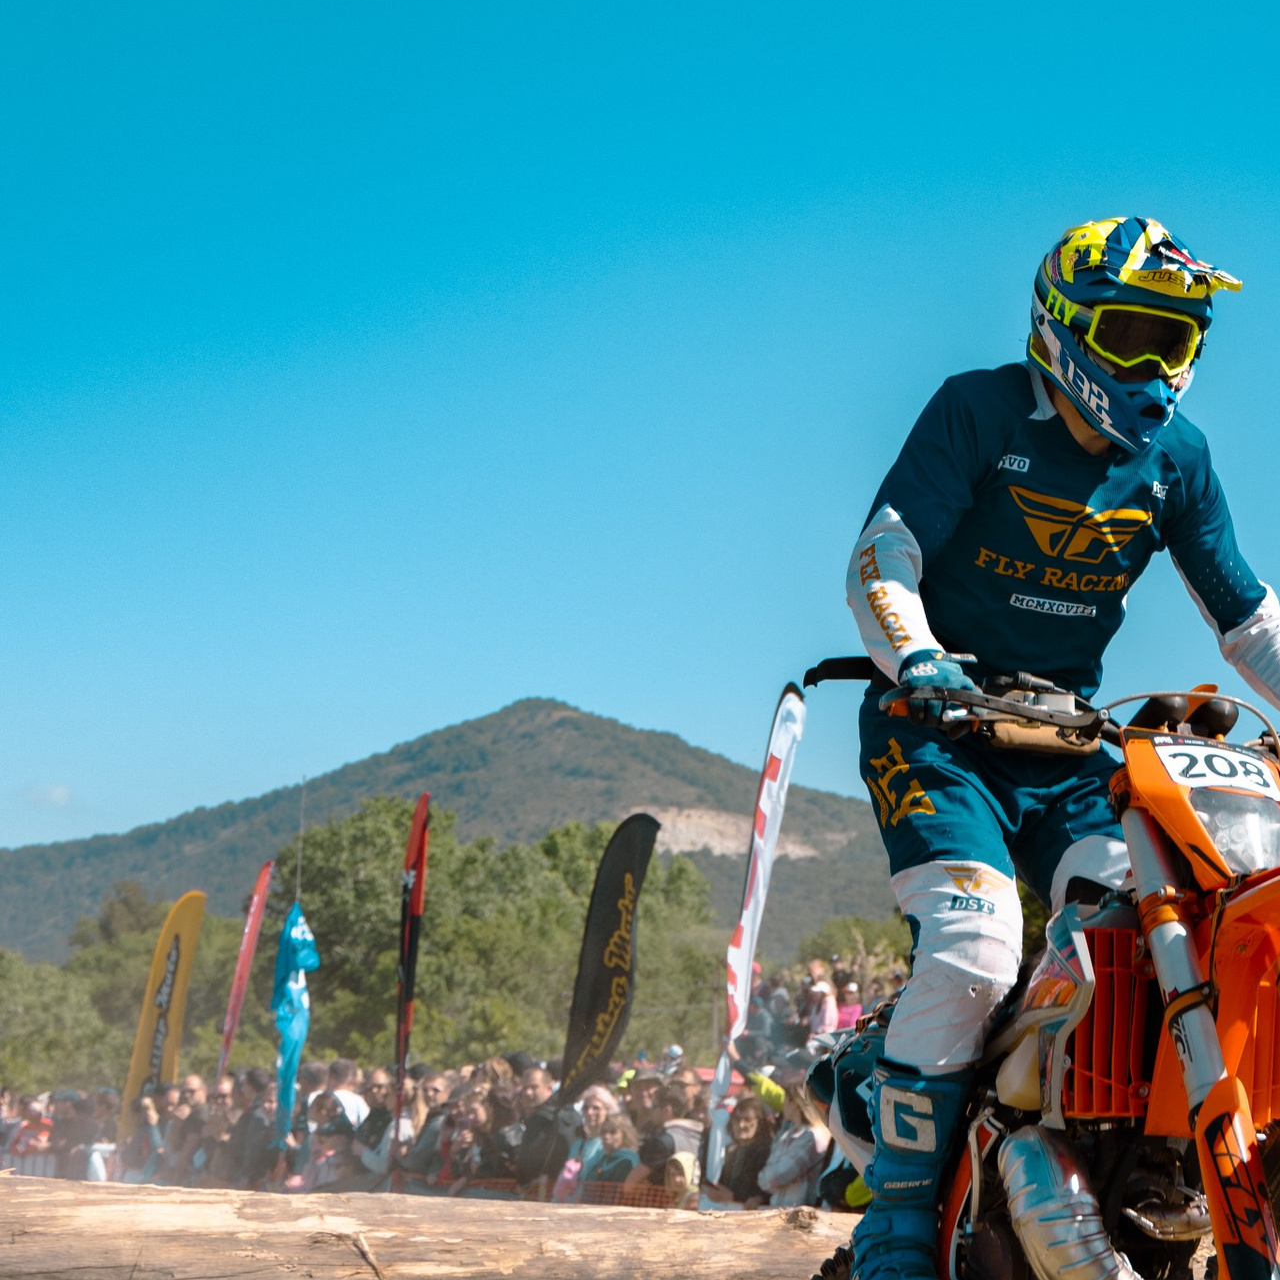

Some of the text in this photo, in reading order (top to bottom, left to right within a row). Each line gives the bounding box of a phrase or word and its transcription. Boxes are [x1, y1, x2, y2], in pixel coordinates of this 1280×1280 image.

[1046, 286, 1079, 326] FLY
[859, 543, 881, 587] FLY
[974, 547, 1129, 591] FLY RACIN
[869, 737, 936, 827] FLY
[1168, 752, 1271, 788] 208
